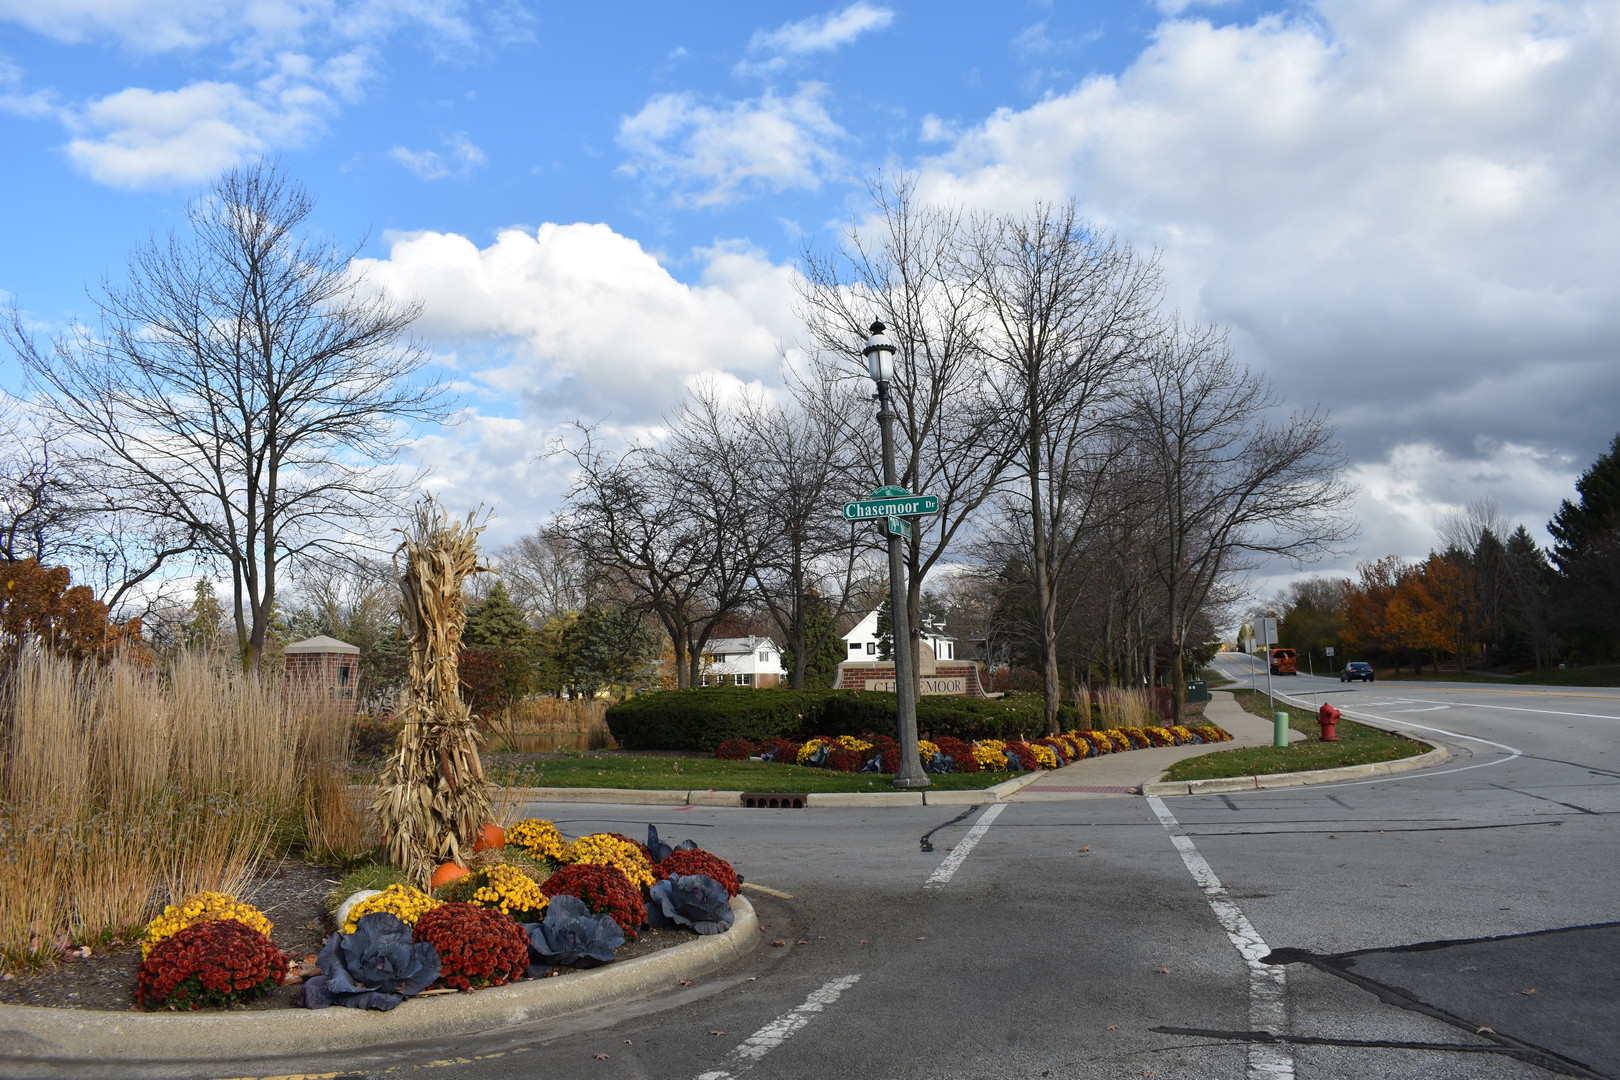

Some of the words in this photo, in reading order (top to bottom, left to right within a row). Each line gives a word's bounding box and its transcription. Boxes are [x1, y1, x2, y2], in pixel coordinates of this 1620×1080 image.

[845, 502, 919, 518] Chasemoor
[925, 500, 935, 508] Dr
[874, 680, 961, 693] CHEMOOR
